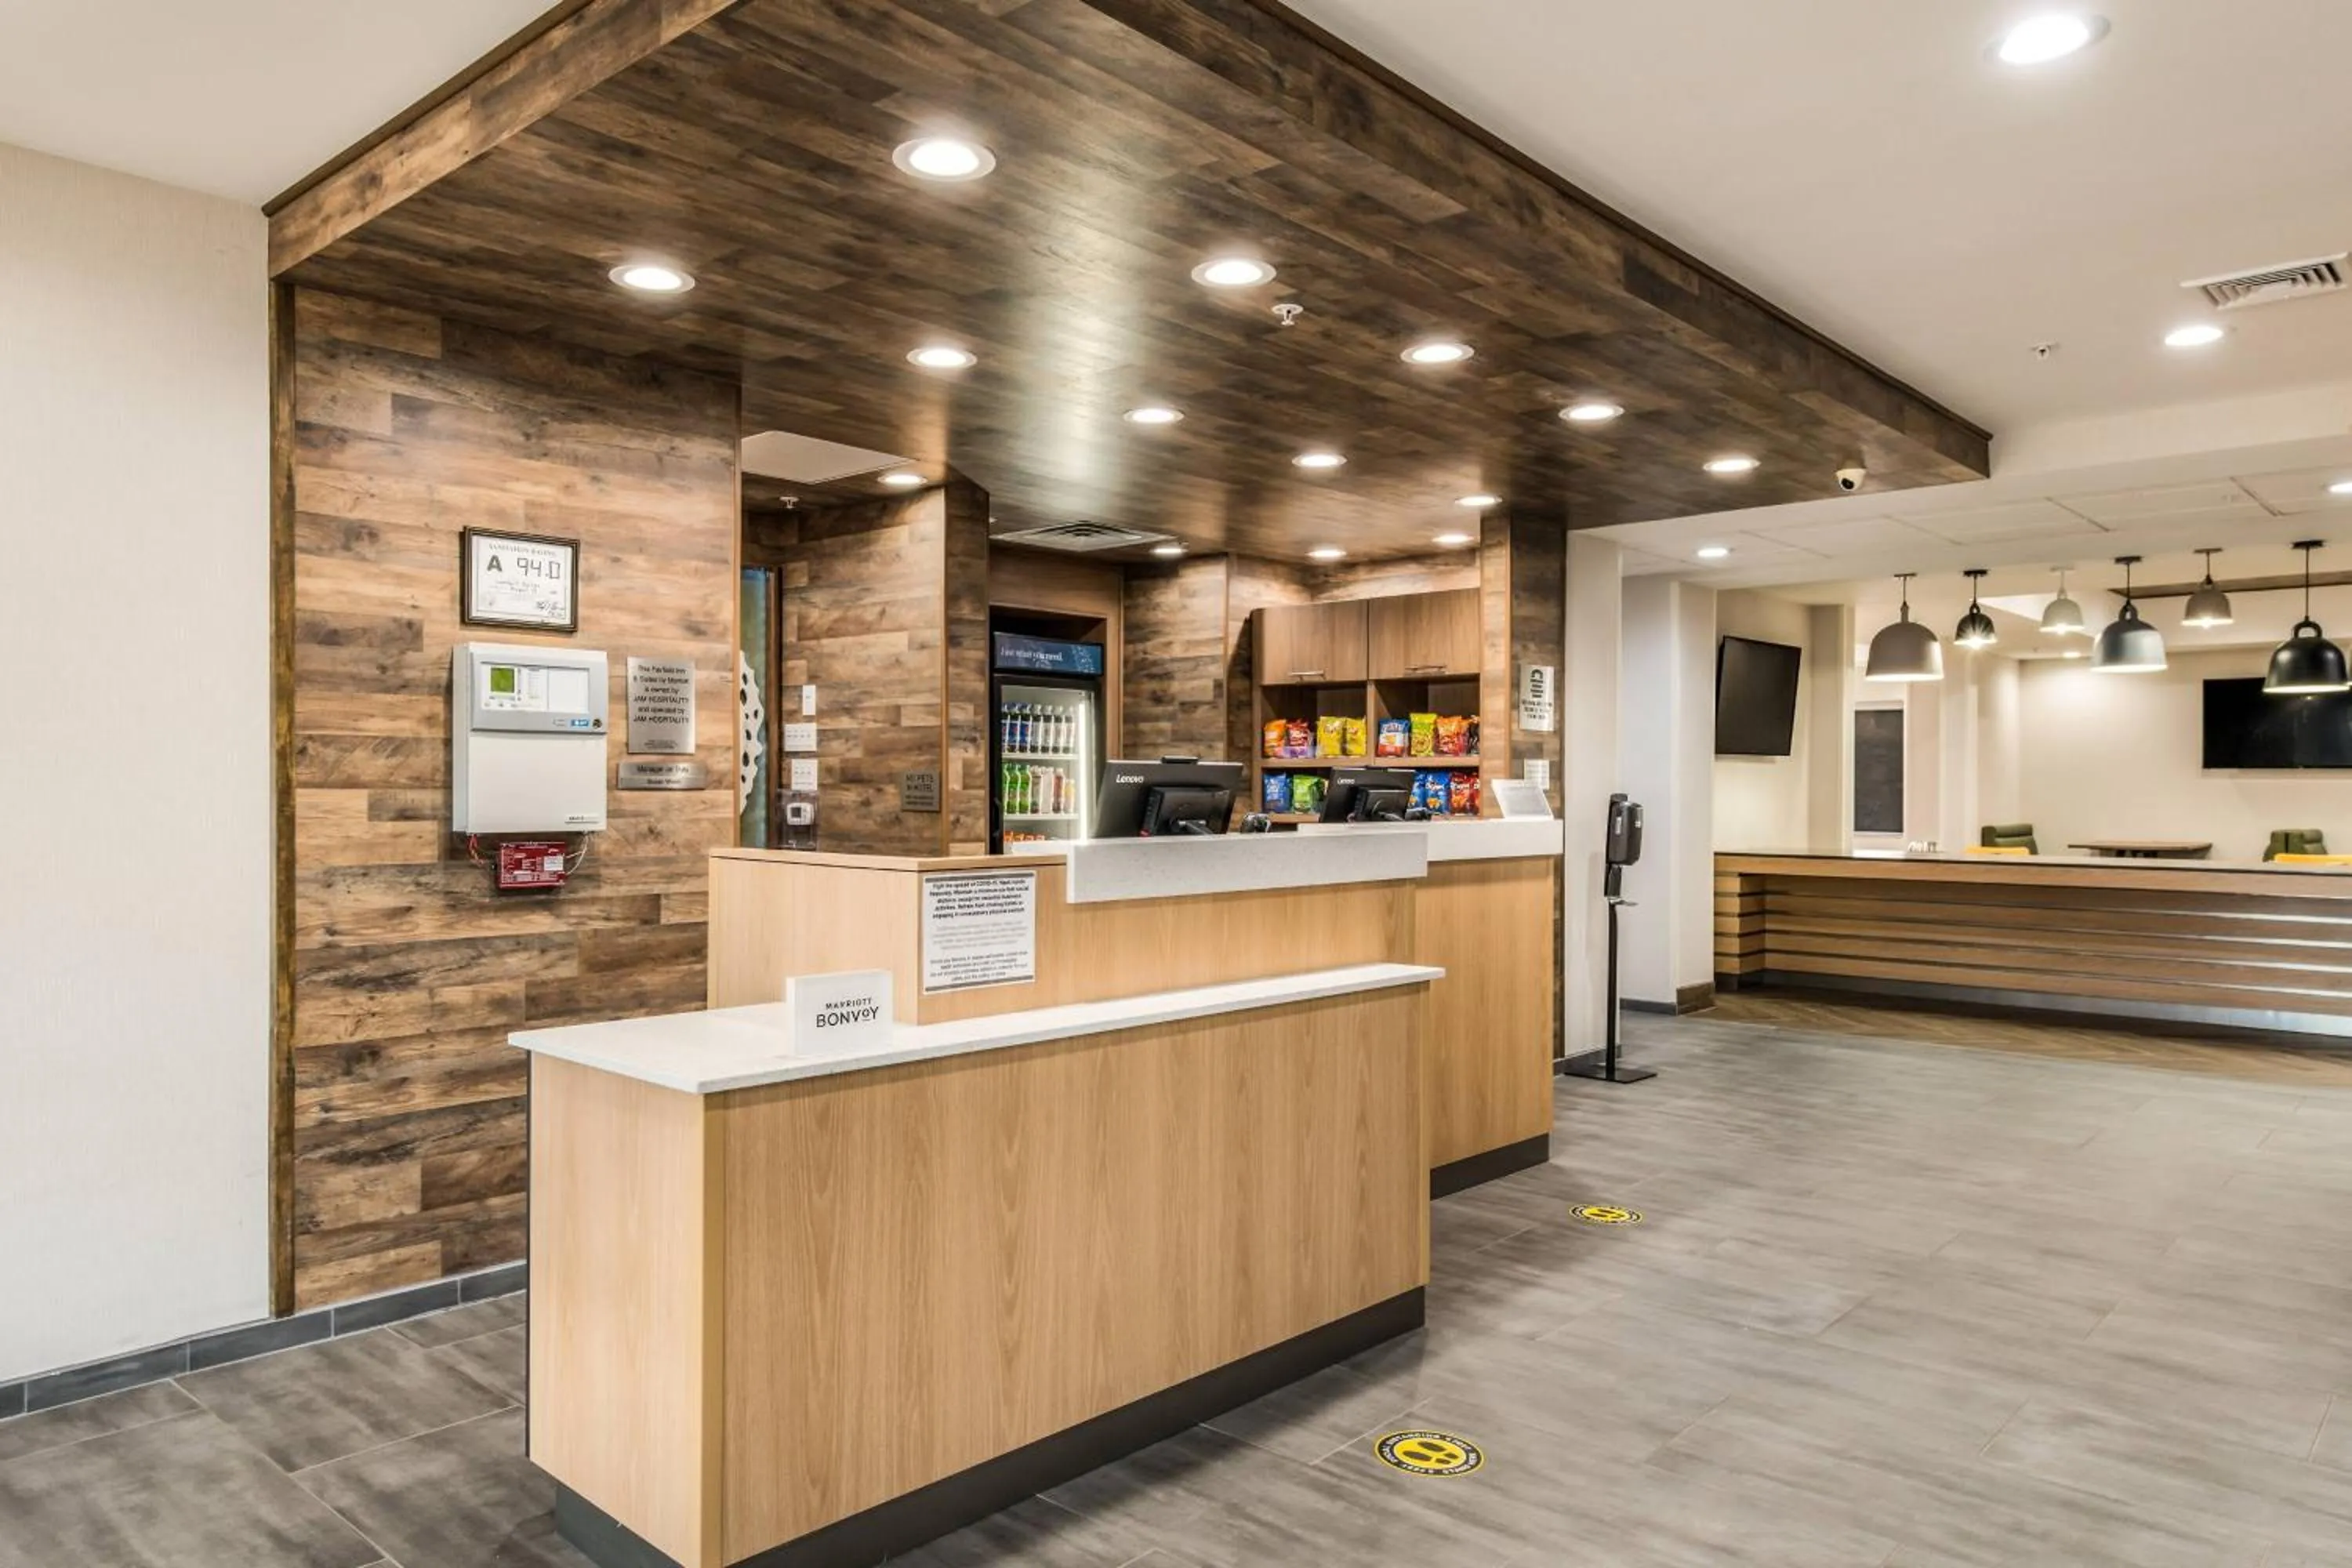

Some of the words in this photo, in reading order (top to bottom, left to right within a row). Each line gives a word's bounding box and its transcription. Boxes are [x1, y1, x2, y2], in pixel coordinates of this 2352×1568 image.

[487, 554, 503, 572] A
[517, 557, 561, 579] 94.0
[1116, 774, 1144, 783] Lenovo
[826, 997, 872, 1010] MARRIOTT
[816, 1006, 879, 1028] BONVOY
